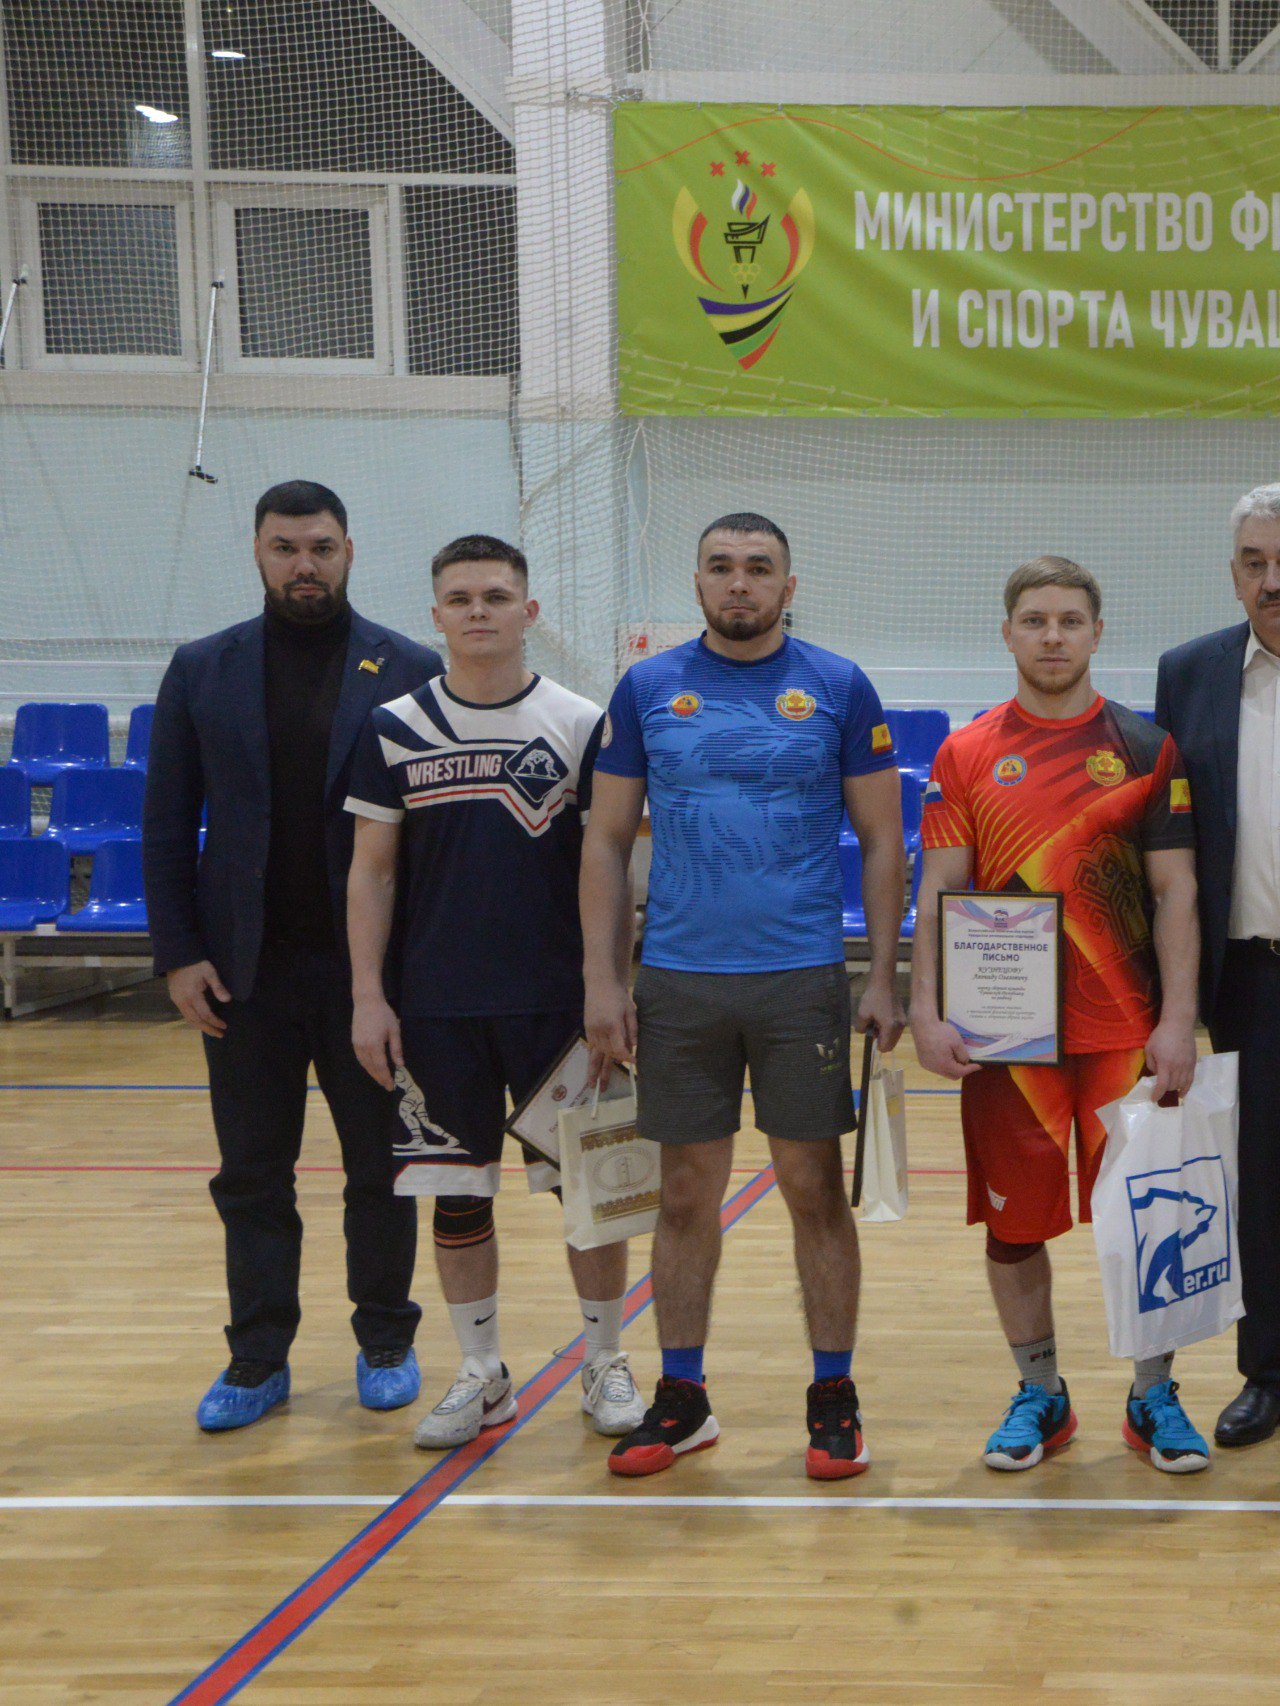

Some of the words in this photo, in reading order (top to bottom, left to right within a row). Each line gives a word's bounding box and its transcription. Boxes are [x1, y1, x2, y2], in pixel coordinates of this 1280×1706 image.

[854, 191, 1213, 253] МИНИСТЕРСТВО
[911, 289, 940, 348] И
[957, 289, 1134, 349] СПОРТА
[406, 754, 503, 787] WRESTLING
[954, 942, 1049, 952] БЛАГОДАРСТВЕННОЕ
[982, 953, 1020, 962] ПИСЬМО
[1183, 1262, 1227, 1295] er.ru
